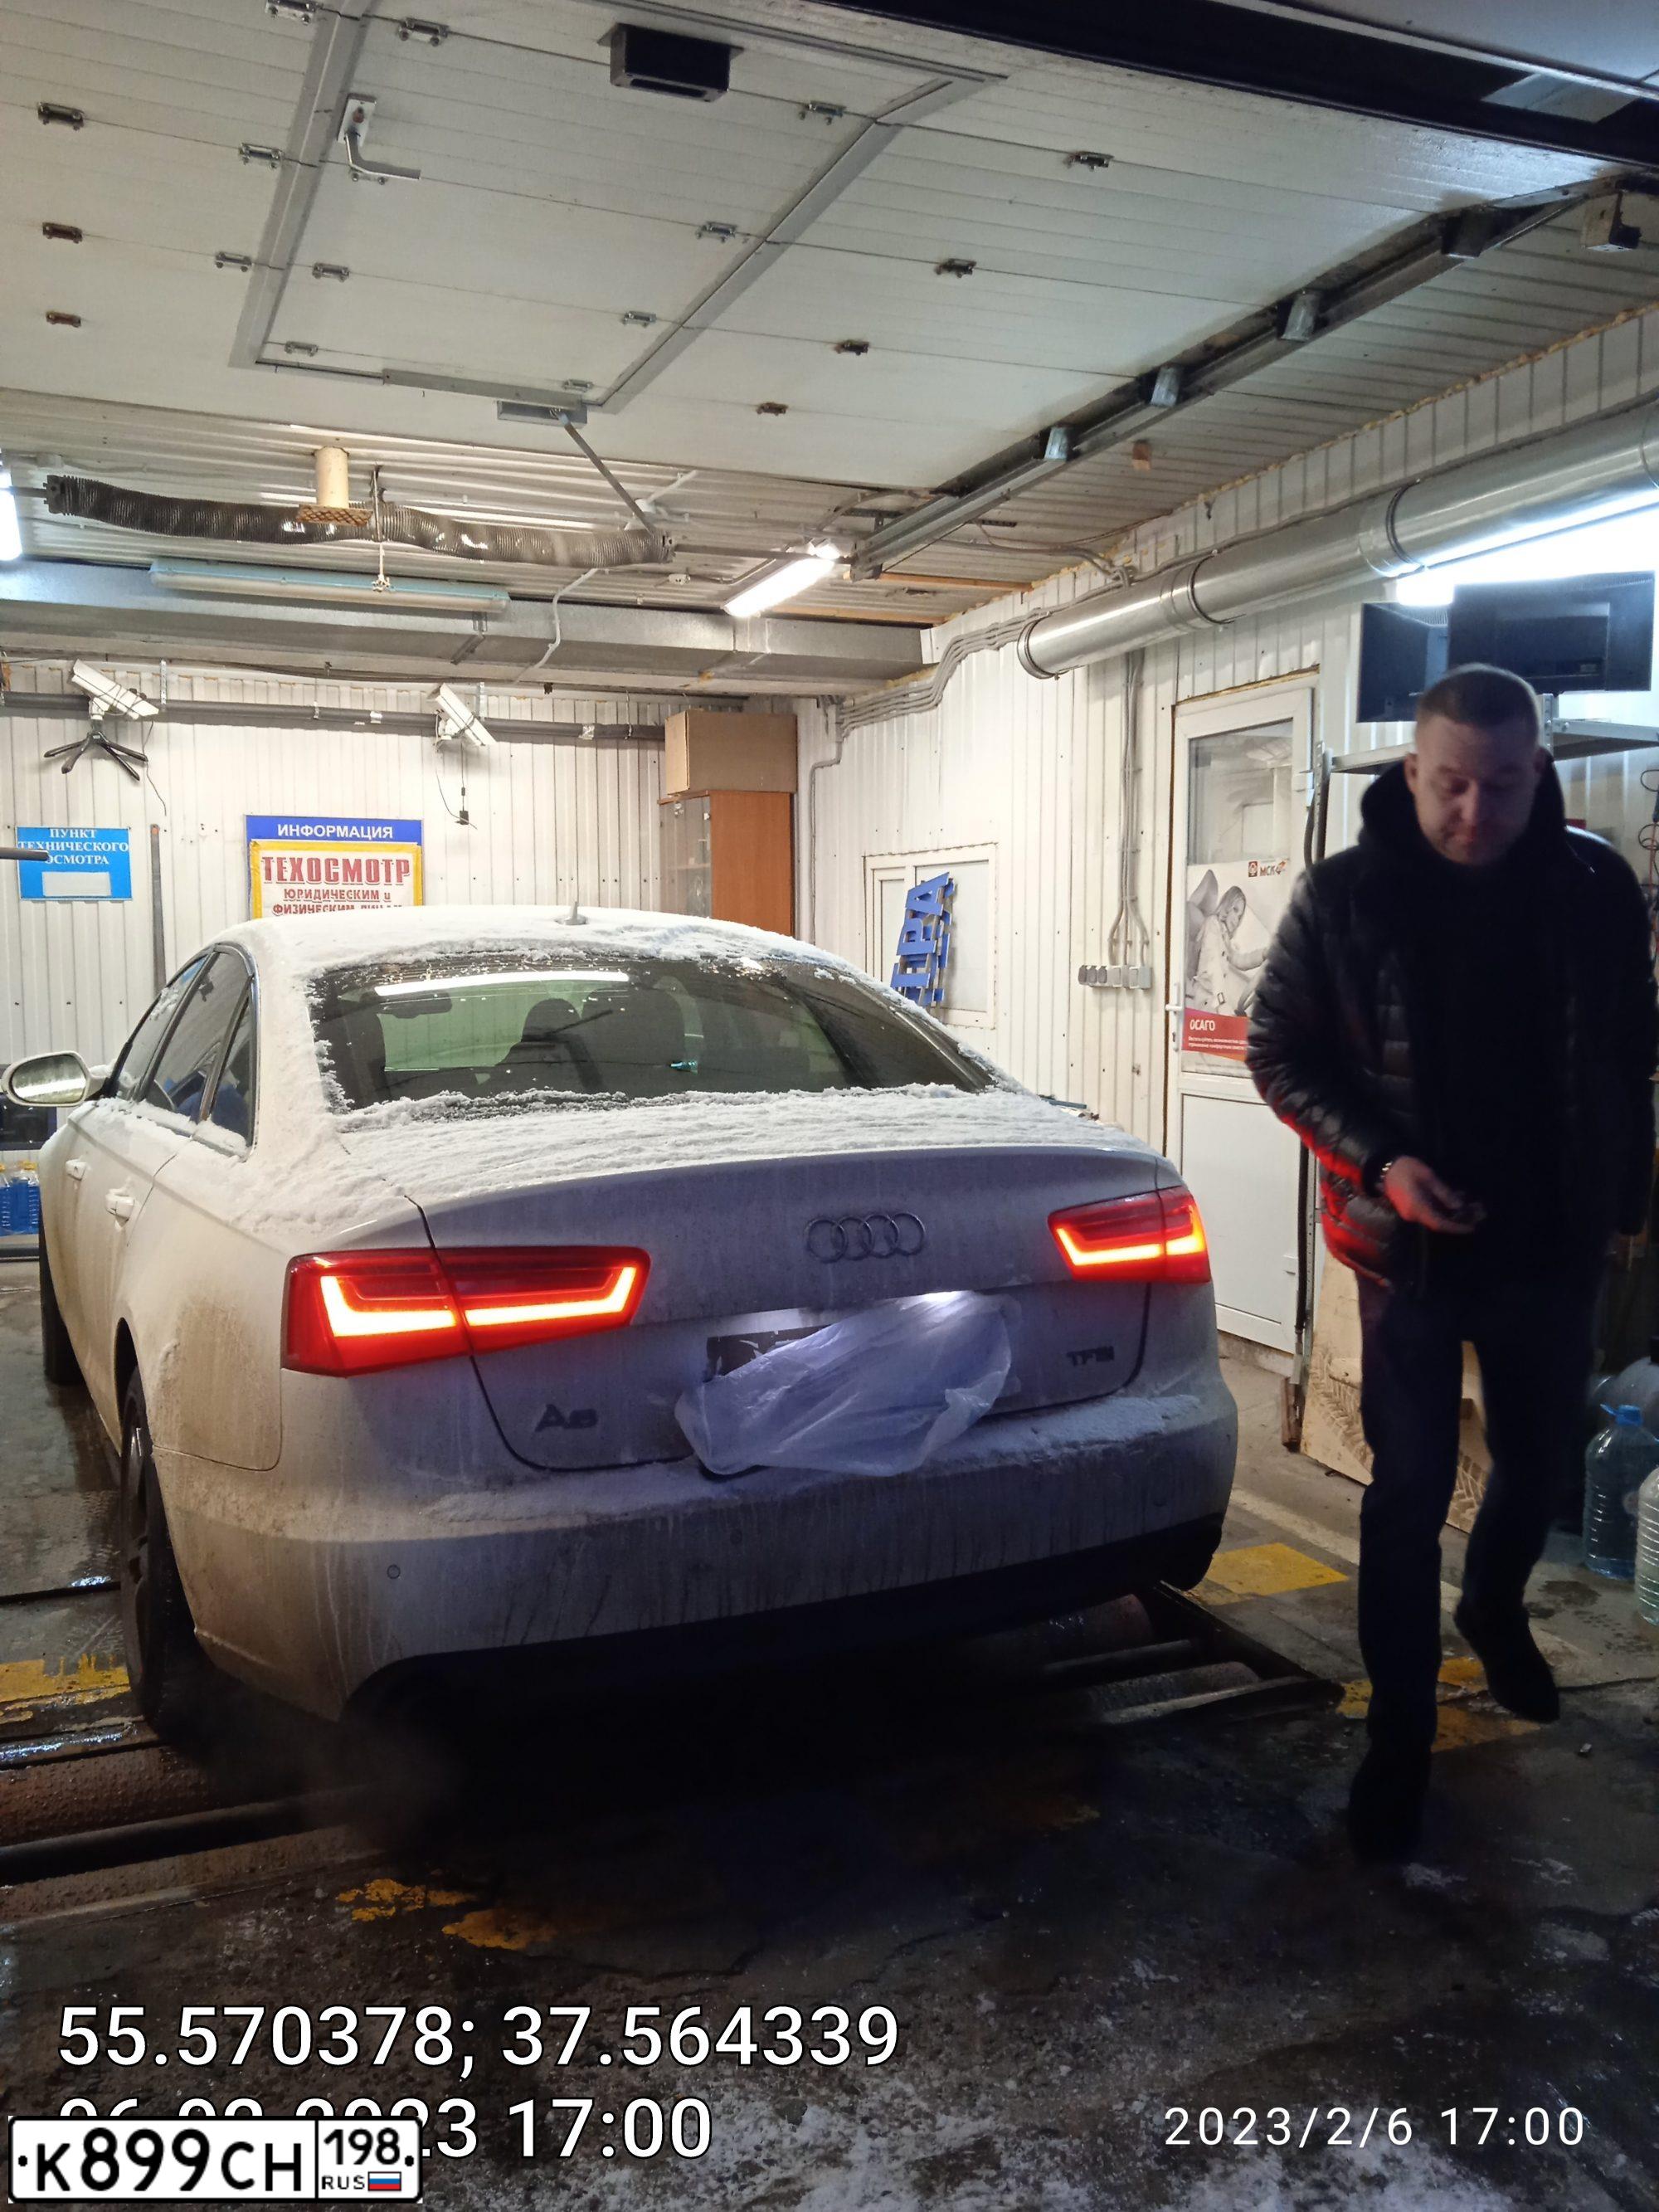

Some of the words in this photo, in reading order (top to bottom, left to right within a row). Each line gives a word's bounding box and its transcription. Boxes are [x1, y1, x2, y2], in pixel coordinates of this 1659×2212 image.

[50, 829, 98, 838] ПУНКТ
[277, 824, 394, 840] ИНФОРМАЦИЯ
[17, 840, 129, 852] ТЕХНИЧЕСКОГО
[45, 855, 109, 865] ОСМОТРА
[261, 856, 411, 885] ТЕХОСМОТР
[284, 889, 380, 903] ЮРИДИЧЕСКИМ
[1190, 1020, 1215, 1031] ОСАГО
